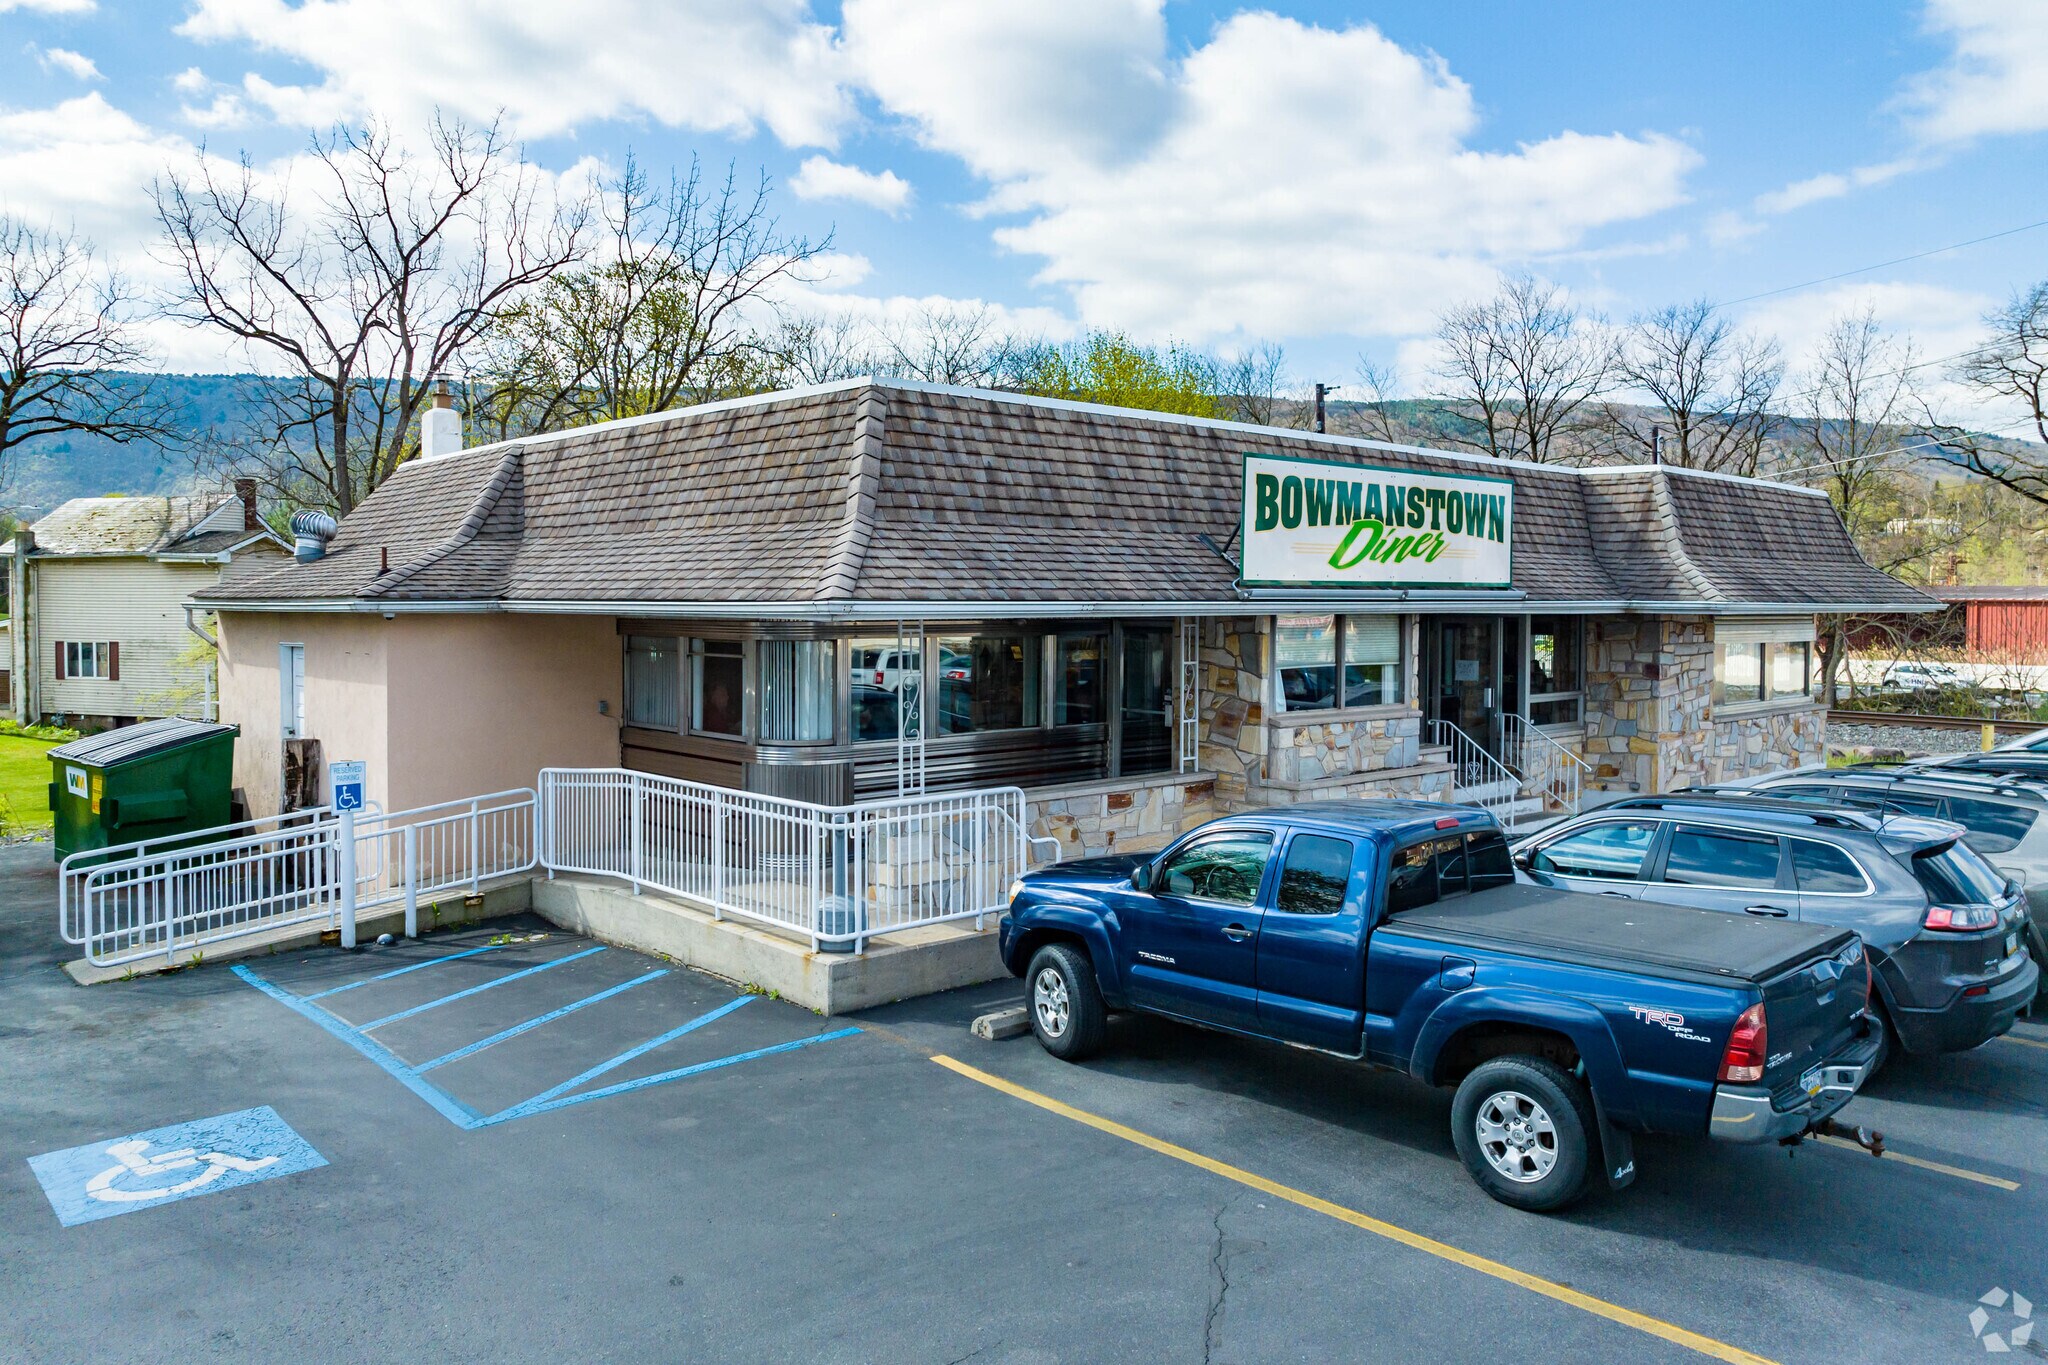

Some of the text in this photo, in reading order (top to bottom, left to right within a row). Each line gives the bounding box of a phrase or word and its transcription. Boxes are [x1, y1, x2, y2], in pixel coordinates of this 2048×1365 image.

[1255, 473, 1506, 543] BOWMANSTOWN
[1328, 519, 1446, 570] Diner
[333, 765, 362, 774] RESERVED
[336, 774, 360, 782] PARKING
[1138, 951, 1176, 964] TACOMA
[1628, 1006, 1684, 1028] TRD
[1667, 1025, 1693, 1034] OFF
[1675, 1032, 1711, 1043] ROAD
